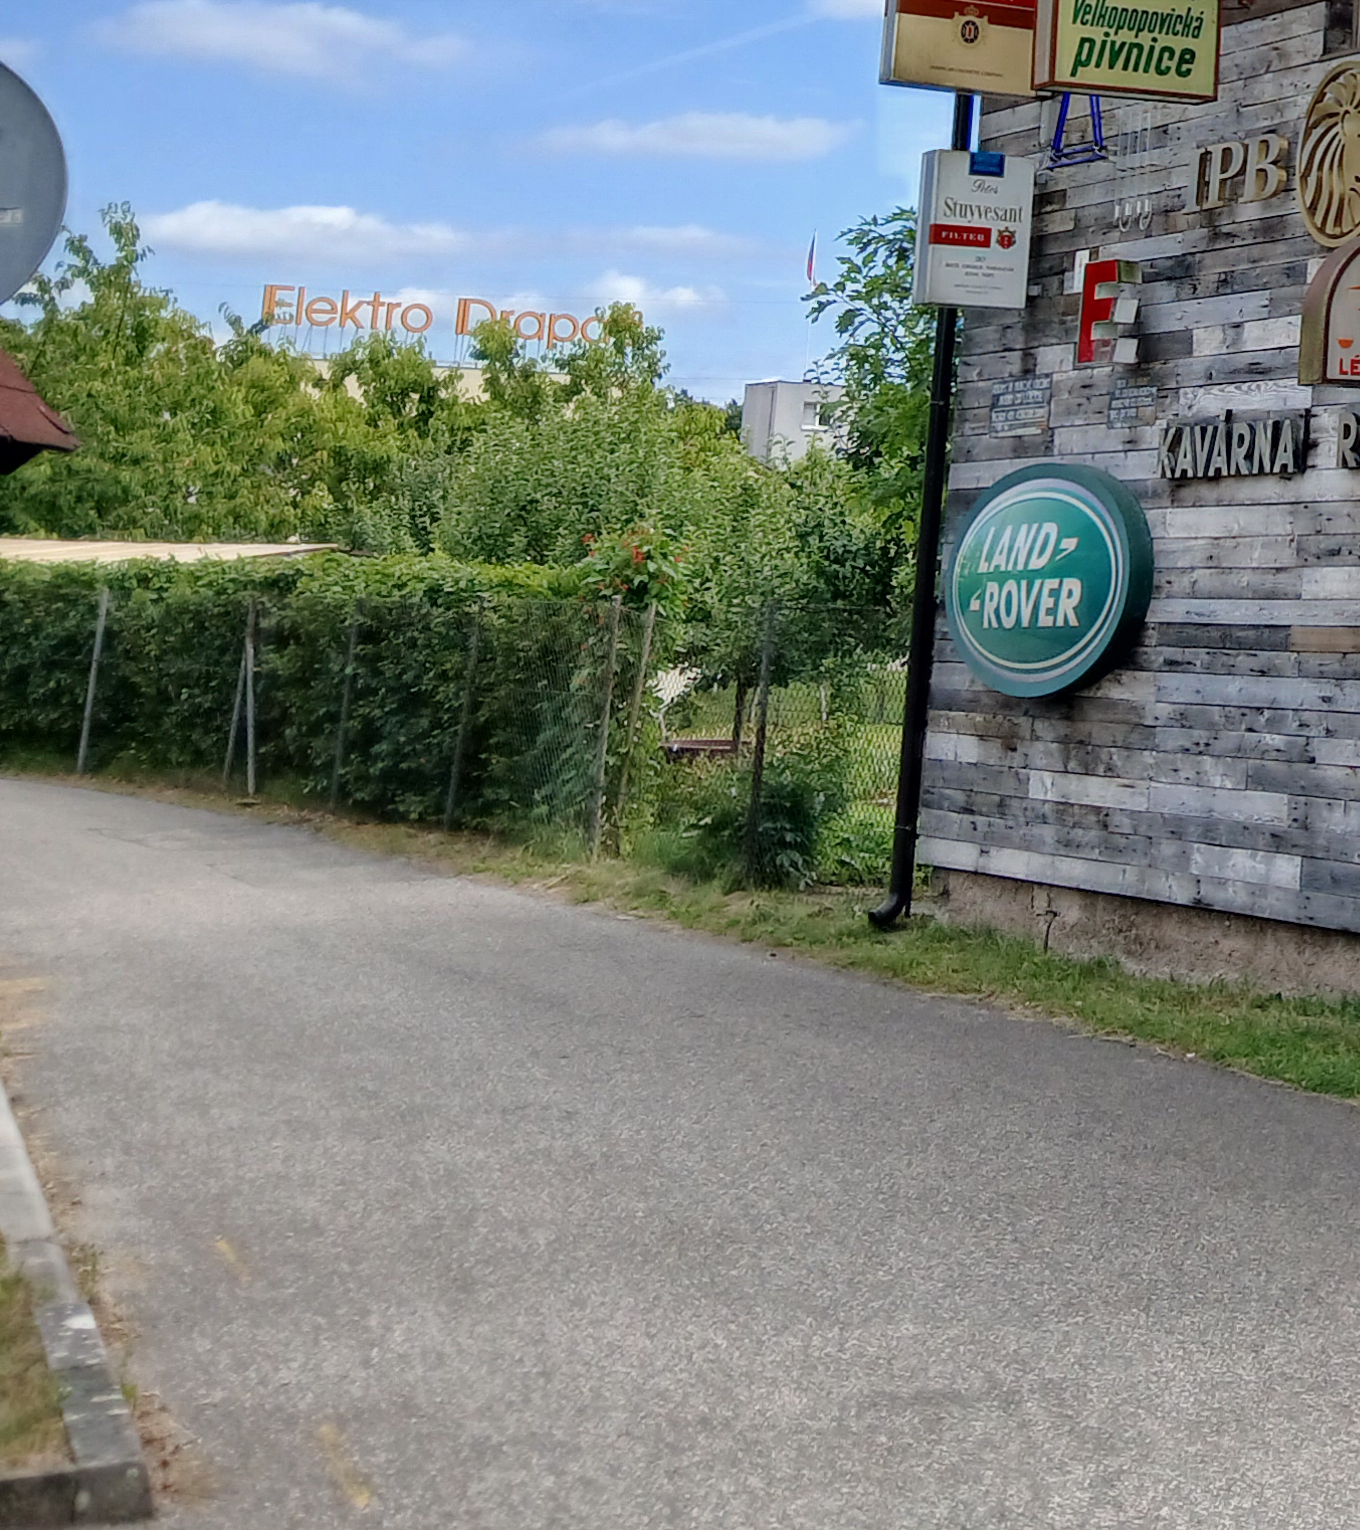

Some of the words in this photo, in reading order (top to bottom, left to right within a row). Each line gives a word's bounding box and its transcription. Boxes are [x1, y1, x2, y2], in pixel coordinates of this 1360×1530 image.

[1070, 31, 1196, 78] pivnice
[943, 196, 1023, 224] Stuyvesant
[941, 230, 985, 242] FILTER
[262, 284, 433, 333] Elektro
[455, 298, 644, 350] Drapa
